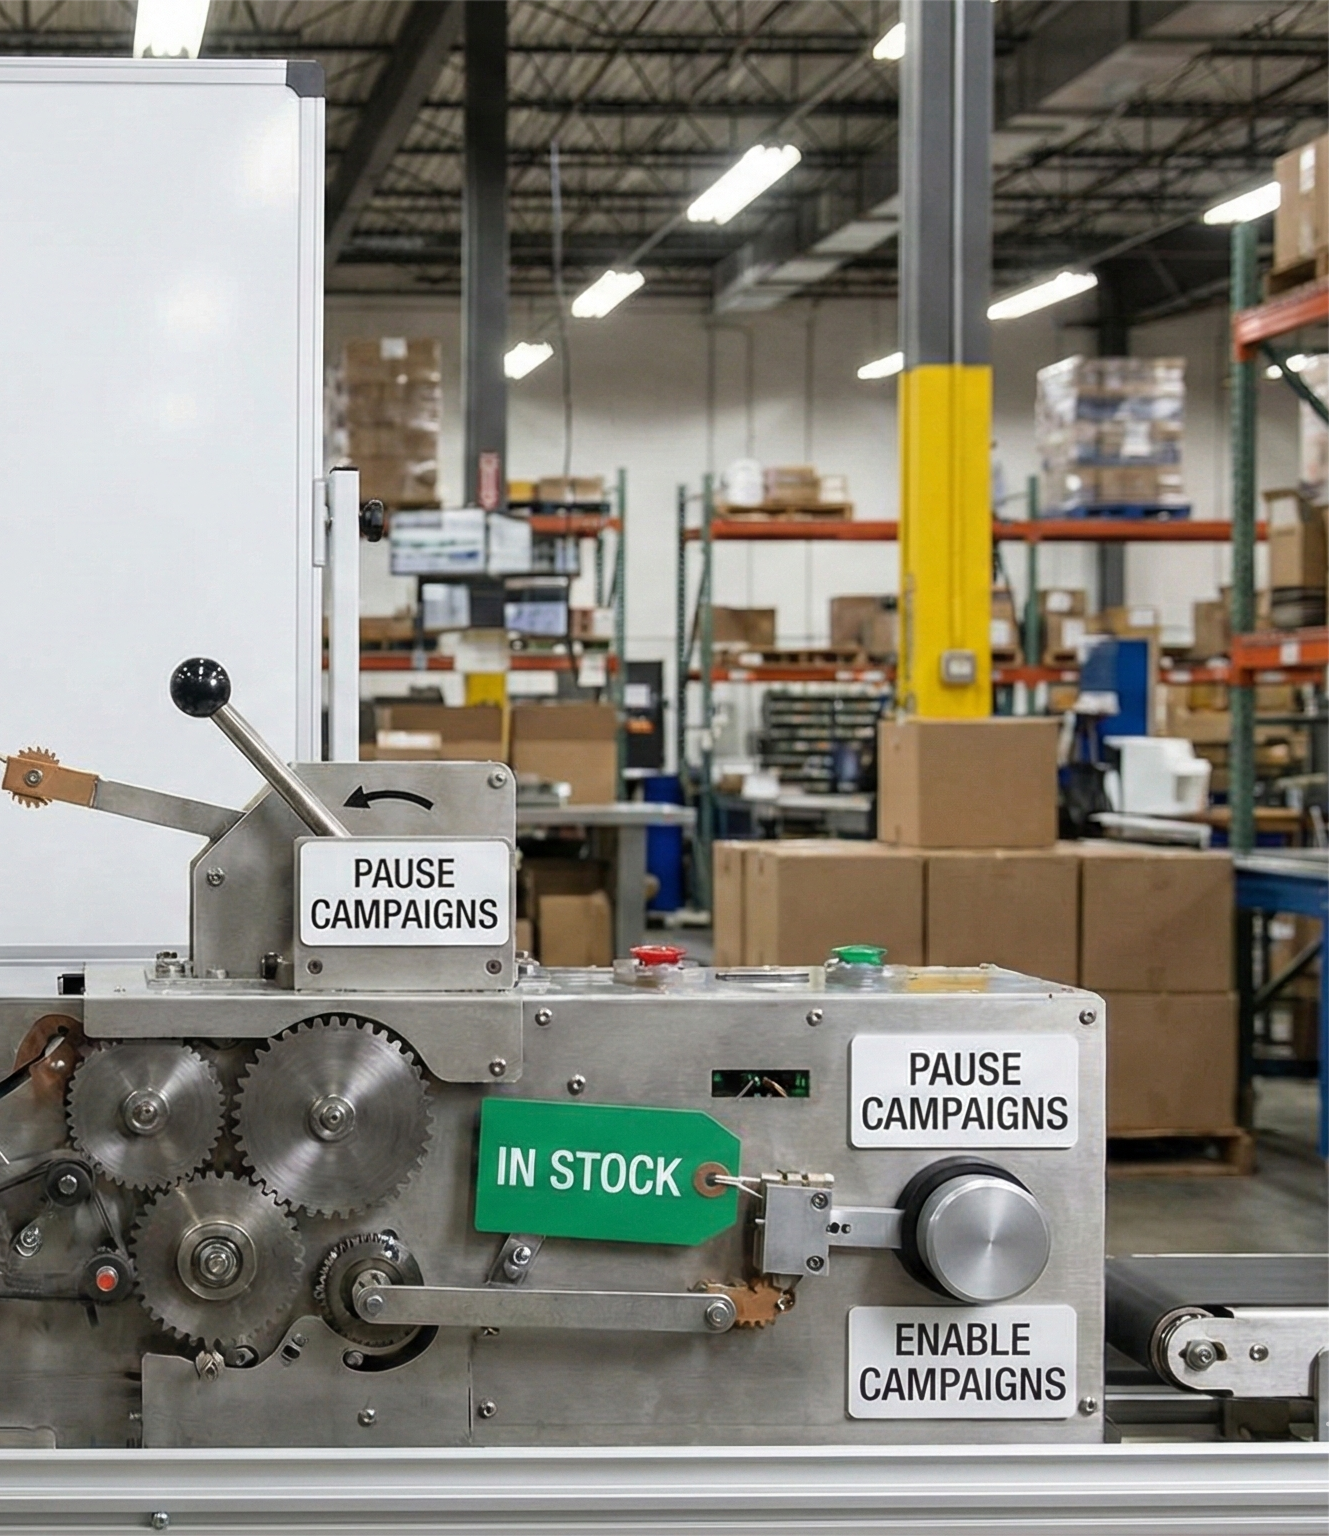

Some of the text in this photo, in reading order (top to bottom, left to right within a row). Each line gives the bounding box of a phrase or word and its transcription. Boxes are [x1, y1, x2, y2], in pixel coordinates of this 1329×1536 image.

[354, 857, 455, 889] PAUSE
[311, 898, 498, 930] CAMPAIGNS
[910, 1051, 1021, 1086] PAUSE
[862, 1096, 1068, 1131] CAMPAIGNS
[497, 1146, 682, 1197] IN STOCK
[895, 1322, 1031, 1356] ENABLE
[859, 1366, 1066, 1402] CAMPAIGNS
